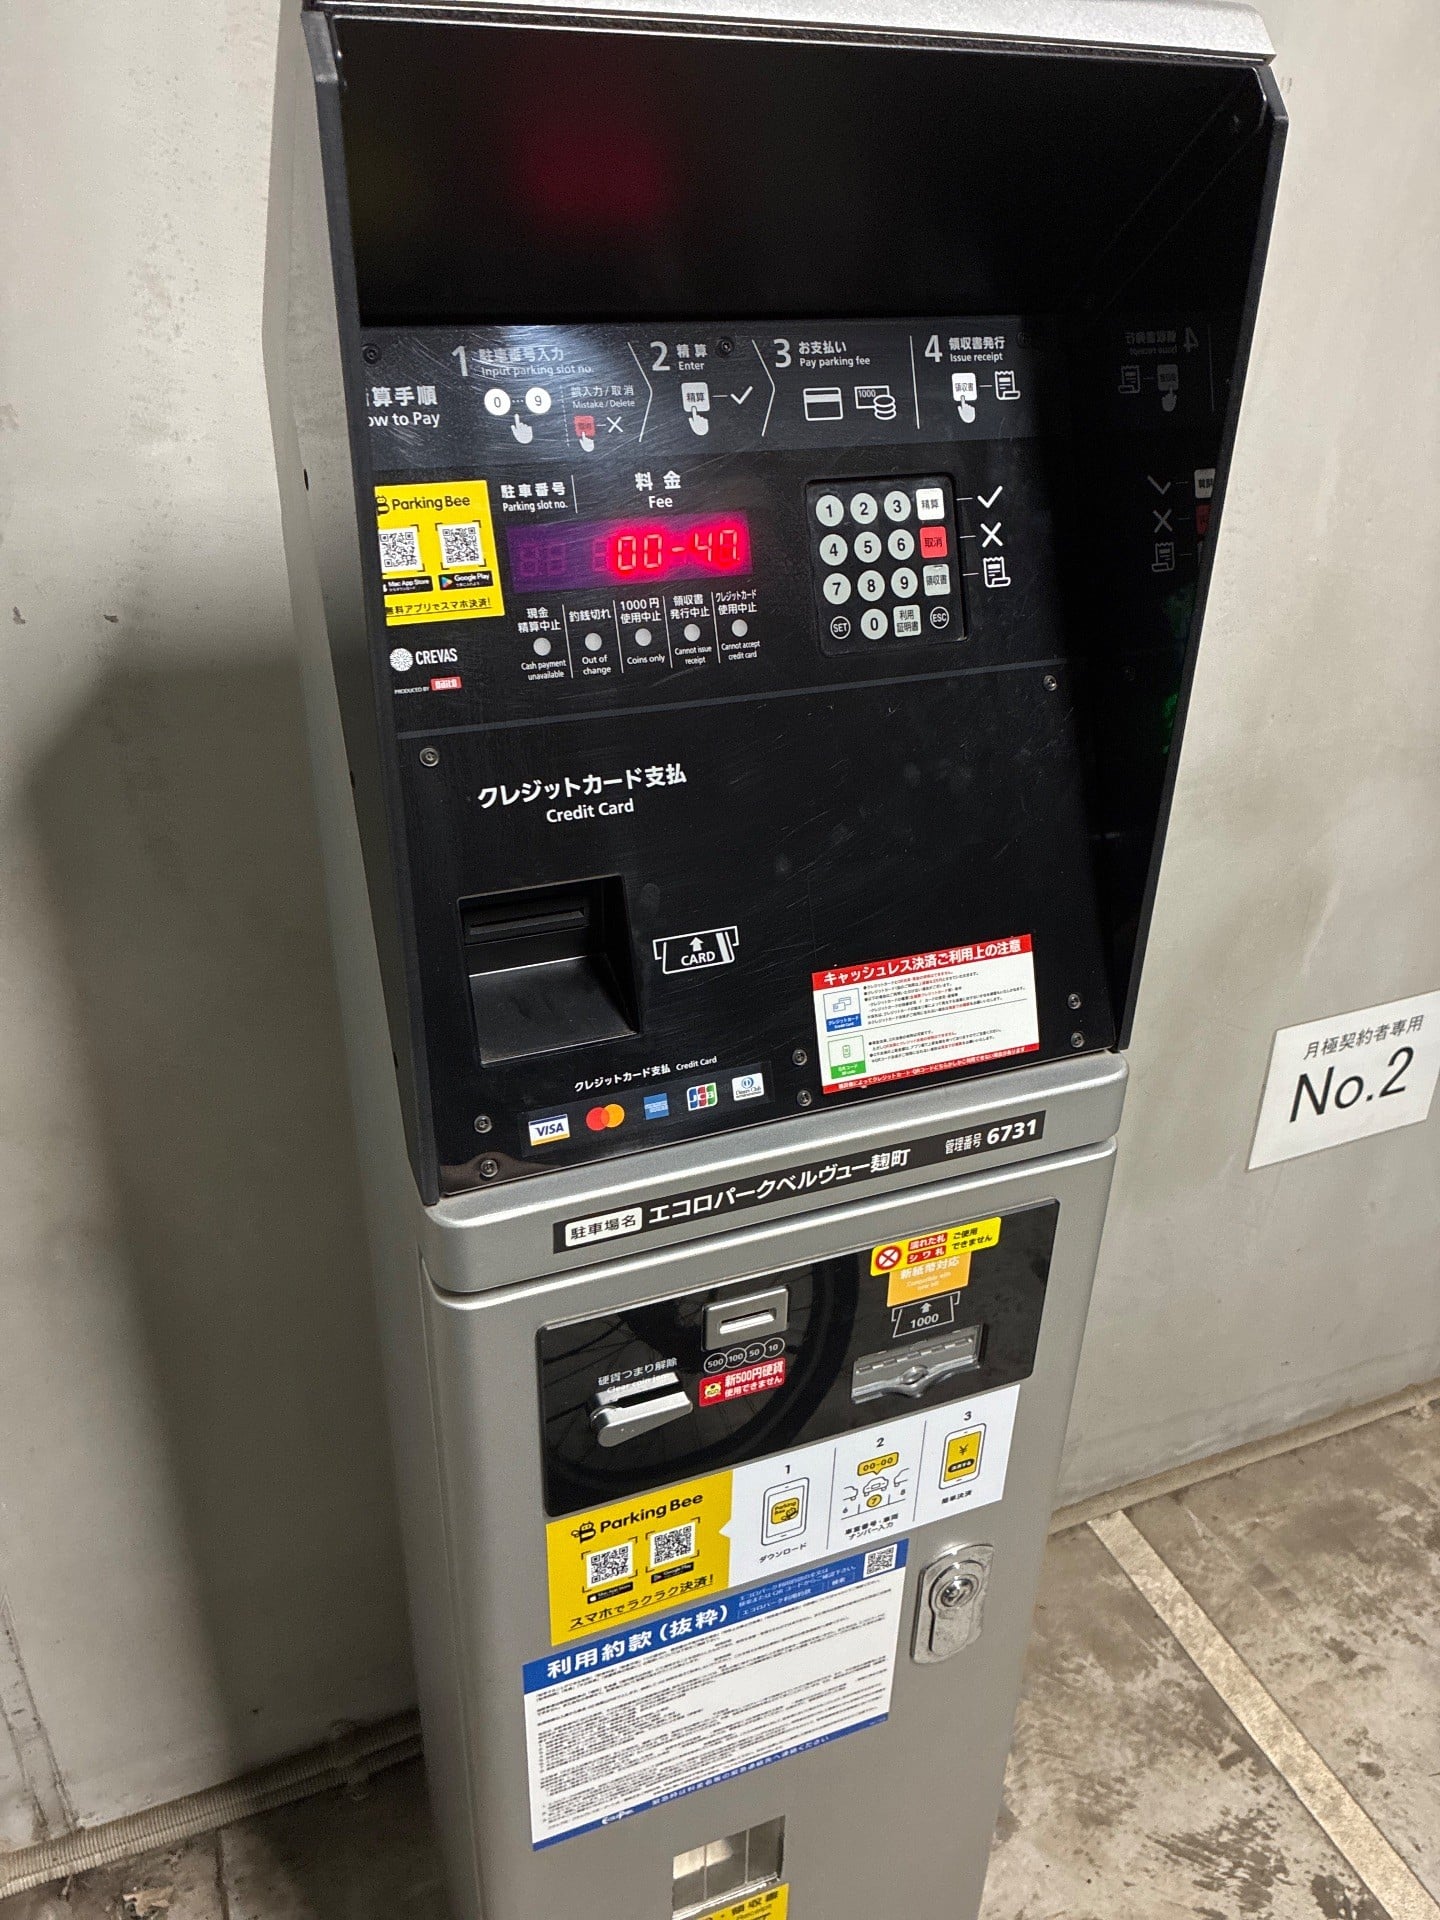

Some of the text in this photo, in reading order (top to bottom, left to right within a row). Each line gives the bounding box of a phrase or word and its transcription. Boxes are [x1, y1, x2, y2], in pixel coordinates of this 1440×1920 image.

[676, 343, 708, 359] 精算
[798, 339, 848, 355] お支払い
[924, 334, 943, 363] 4
[948, 336, 1005, 351] 領収書発行
[451, 345, 469, 377] 1
[478, 346, 565, 364] 駐車番号入力
[650, 341, 670, 371] 2
[773, 338, 793, 369] 3
[800, 353, 871, 369] Pay parking fee
[949, 350, 1004, 364] Issue receipt
[481, 362, 595, 378] Input parking slot no.
[678, 360, 705, 371] Enter
[365, 384, 438, 408] 算手順
[493, 394, 543, 409] 0 9
[857, 388, 877, 400] 1000
[392, 413, 409, 426] to
[412, 411, 440, 428] Pay
[635, 470, 682, 491] 料金
[500, 482, 566, 500] 駐車番号
[392, 494, 471, 512] Parking Bee
[503, 499, 569, 512] Parking slot no.
[649, 495, 673, 509] Fee
[859, 502, 869, 515] 2
[893, 500, 901, 513] 3
[825, 504, 833, 517] 1
[617, 529, 740, 571] 00-47
[829, 543, 838, 556] 4
[864, 540, 872, 553] 5
[897, 538, 905, 551] 6
[924, 537, 943, 548] 取消
[832, 582, 841, 595] 7
[867, 579, 876, 592] 8
[900, 577, 908, 590] 9
[673, 593, 704, 606] 領収書
[715, 589, 758, 603] クレジットカード
[620, 597, 660, 612] 1000円
[718, 602, 758, 616] 使用中止
[526, 606, 550, 619] 現金
[568, 610, 612, 623] 釣銭切れ
[620, 611, 662, 625] 使用中止
[670, 607, 711, 620] 発行中止
[932, 612, 947, 623] ESC
[517, 620, 562, 635] 精算中止
[832, 623, 849, 633] SET
[870, 618, 879, 631] 0
[674, 645, 712, 656] Cannot issue
[721, 640, 761, 651] Cannot accept
[415, 648, 459, 666] CREVAS
[582, 654, 608, 666] Out of
[627, 654, 666, 666] Coins only
[685, 656, 706, 667] receipt
[728, 650, 758, 661] credit card
[521, 659, 567, 672] Cash payment
[583, 666, 612, 677] change
[527, 670, 566, 681] unavailable
[477, 763, 688, 809] クレジットカード支払
[546, 798, 635, 823] Credit Card
[680, 950, 716, 966] CARD
[823, 938, 1022, 986] キャッシュレス決済ご利用上の注意
[1303, 1014, 1425, 1061] 月極契約者専用
[676, 1055, 718, 1071] Credit Card
[574, 1063, 671, 1092] クレジットカード支払
[1289, 1046, 1415, 1123] No.2
[536, 1122, 565, 1137] VISA
[986, 1117, 1037, 1146] 6731
[944, 1131, 982, 1155] 管理番号
[647, 1148, 912, 1226] エコロパークベルヴュー麹町
[570, 1212, 637, 1241] 駐車場名
[953, 1228, 978, 1240] ご使用
[951, 1235, 993, 1250] できません
[910, 1313, 939, 1329] 1000
[707, 1344, 779, 1369] 500 100 50 10
[598, 1357, 678, 1386] 硬貨つまり解除
[724, 1377, 783, 1399] 使用できません
[964, 1411, 972, 1422] 3
[876, 1437, 885, 1449] 2
[785, 1465, 792, 1475] 1
[600, 1494, 703, 1534] Parking Bee
[758, 1542, 808, 1564] ダウンロード
